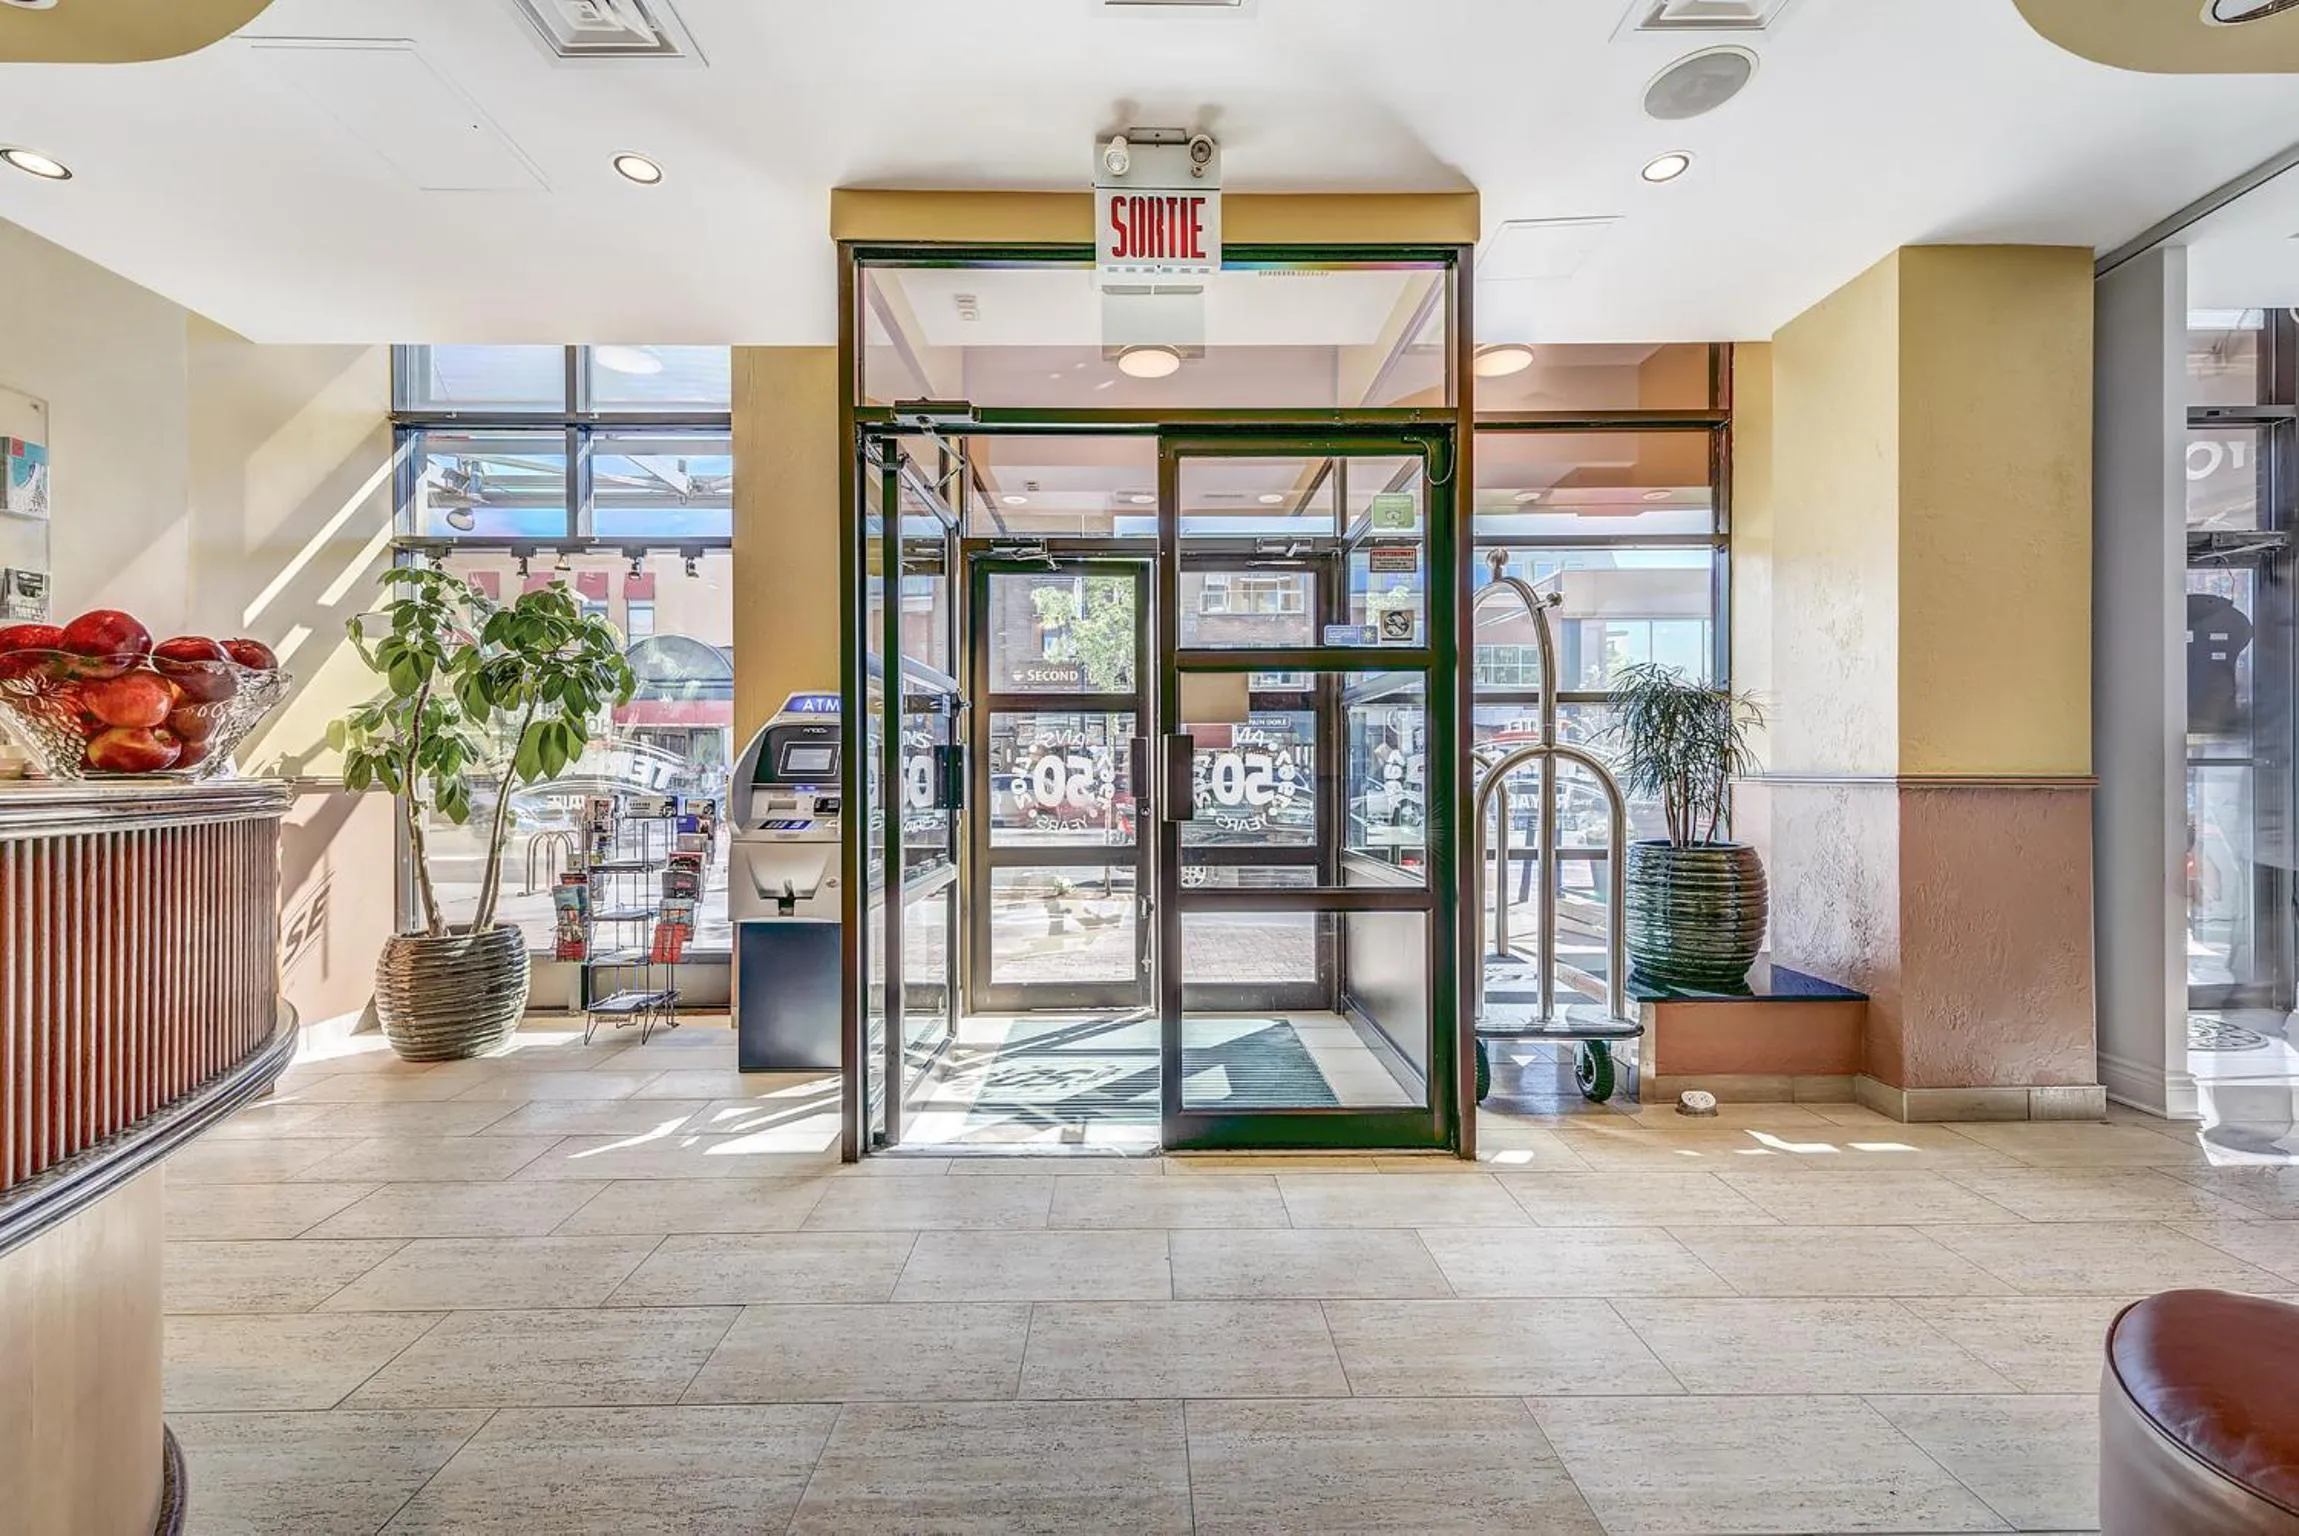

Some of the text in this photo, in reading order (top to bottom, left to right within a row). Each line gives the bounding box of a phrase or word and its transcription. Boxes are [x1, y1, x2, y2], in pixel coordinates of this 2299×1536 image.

[1110, 195, 1206, 259] SORTIE
[1027, 669, 1079, 682] SECOND
[802, 698, 840, 712] ATM
